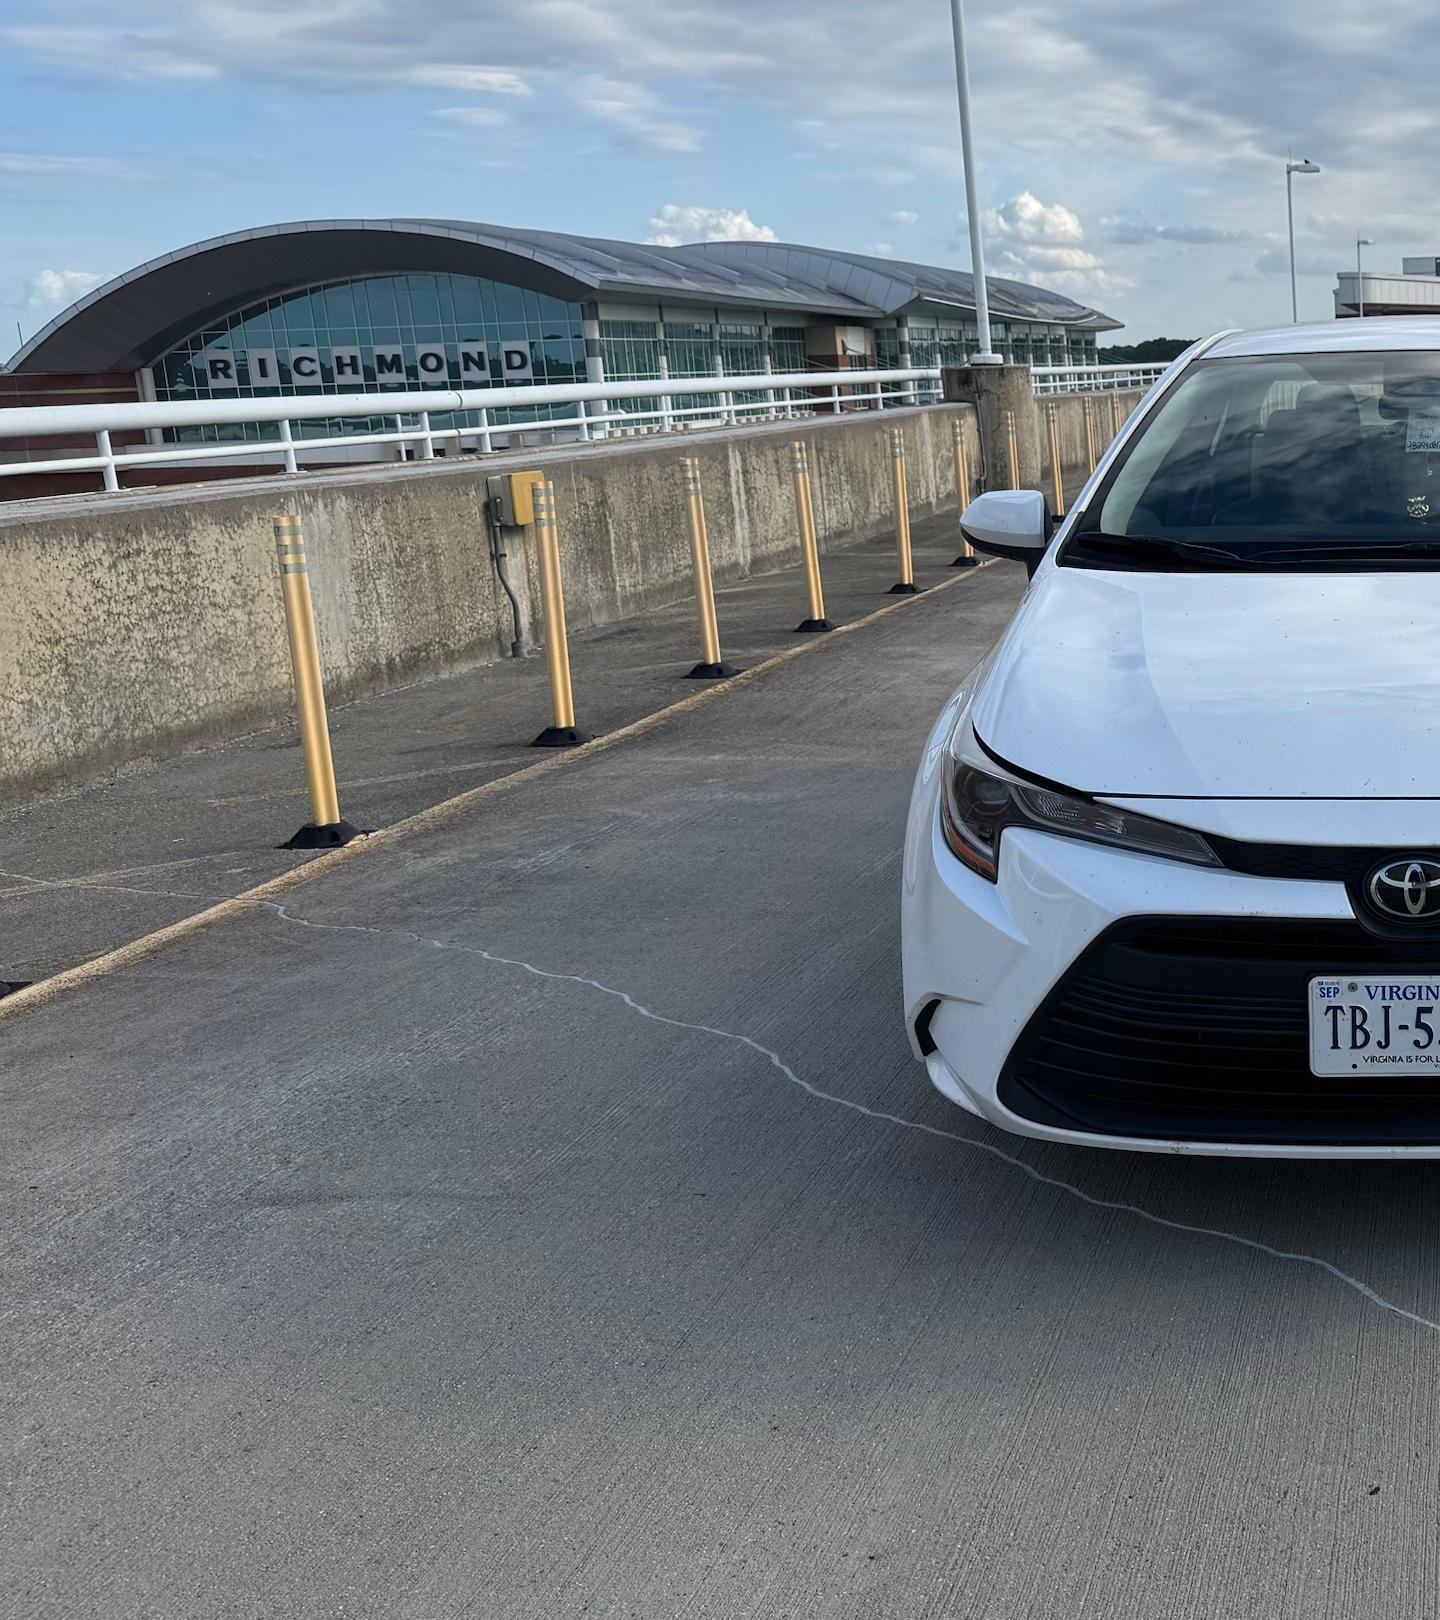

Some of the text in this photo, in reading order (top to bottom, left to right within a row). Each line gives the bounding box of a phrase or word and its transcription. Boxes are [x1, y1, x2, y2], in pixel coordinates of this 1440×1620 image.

[209, 350, 528, 379] RICHMOND
[1319, 986, 1340, 998] SEP
[1362, 1055, 1404, 1063] VIRGINIA
[1405, 1055, 1413, 1063] IS
[1415, 1055, 1434, 1063] FOR
